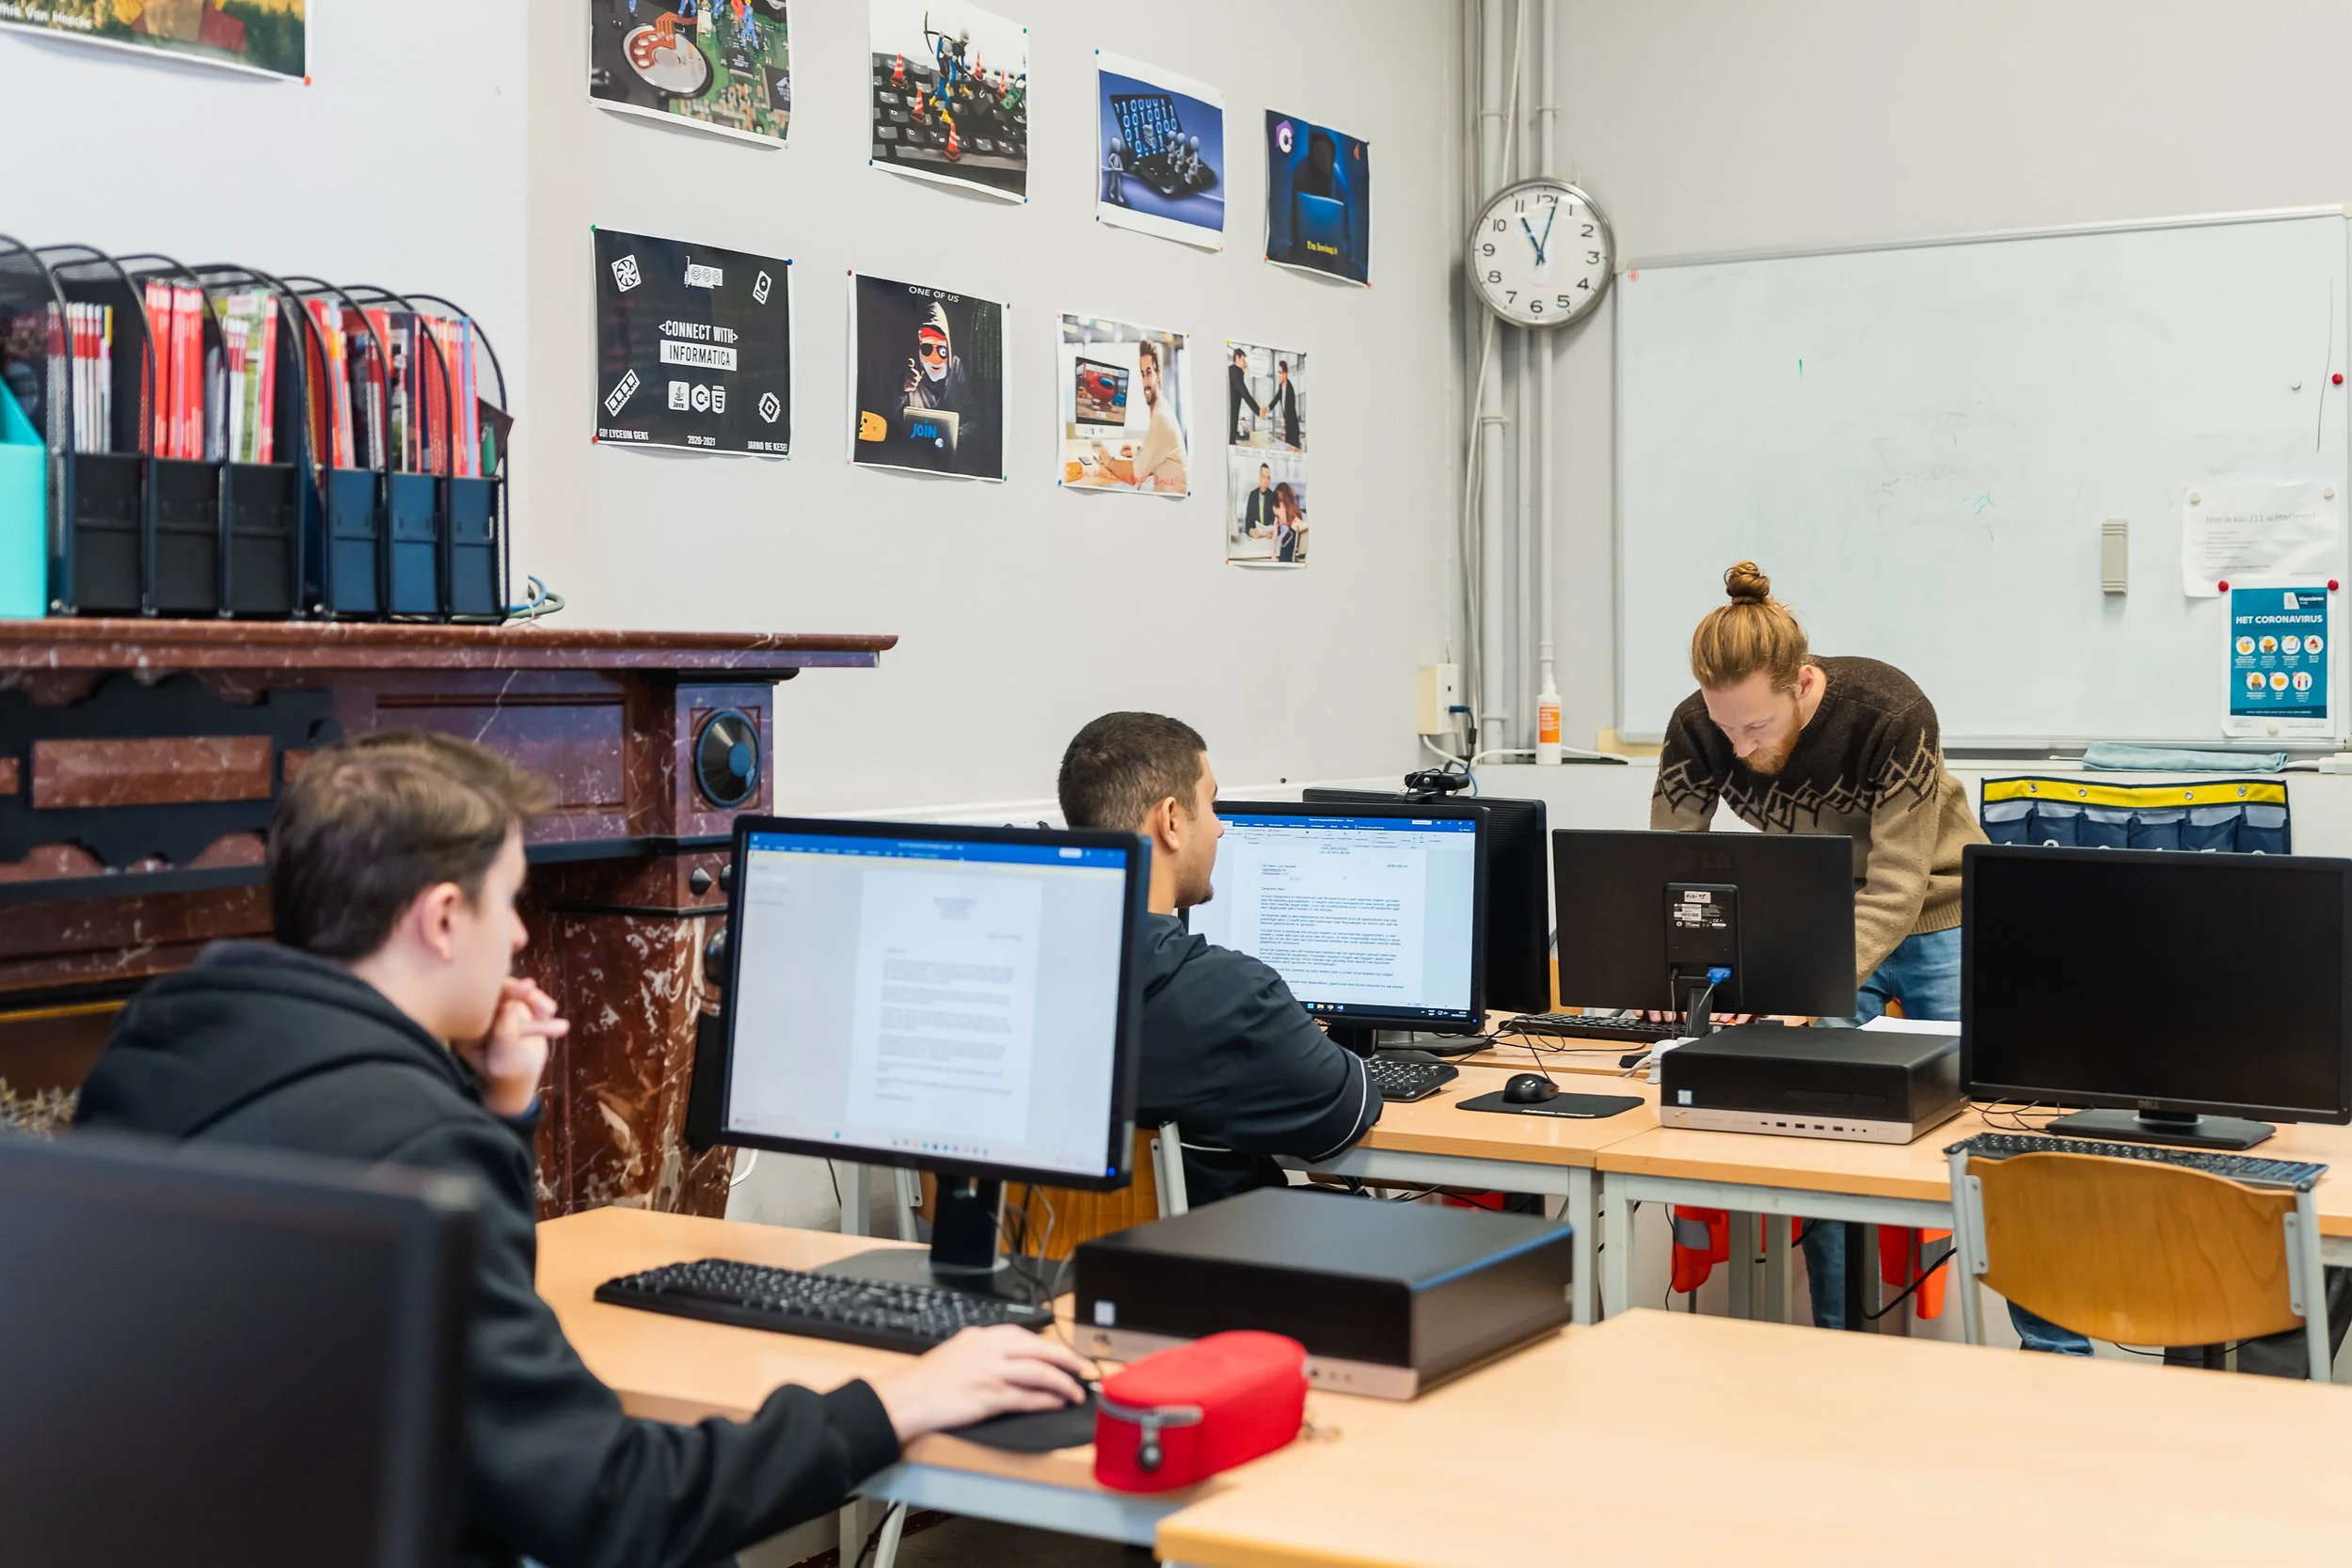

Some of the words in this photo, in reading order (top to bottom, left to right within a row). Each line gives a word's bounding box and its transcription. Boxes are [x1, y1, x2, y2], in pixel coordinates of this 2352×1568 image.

[1515, 199, 1524, 213] 11
[1568, 203, 1573, 216] 1
[1493, 219, 1506, 232] 10
[1581, 224, 1594, 237] 2
[1483, 244, 1495, 257] 9
[1585, 251, 1599, 264] 3
[1487, 271, 1502, 283] 8
[1577, 277, 1589, 291] 4
[909, 286, 930, 296] ONE
[933, 291, 946, 299] OF
[947, 293, 960, 303] US
[1506, 291, 1518, 304] 7
[1530, 300, 1543, 313] 6
[1557, 295, 1570, 309] 5
[669, 344, 731, 367] INFORMATICA
[2255, 614, 2323, 624] CORONAVIRUS
